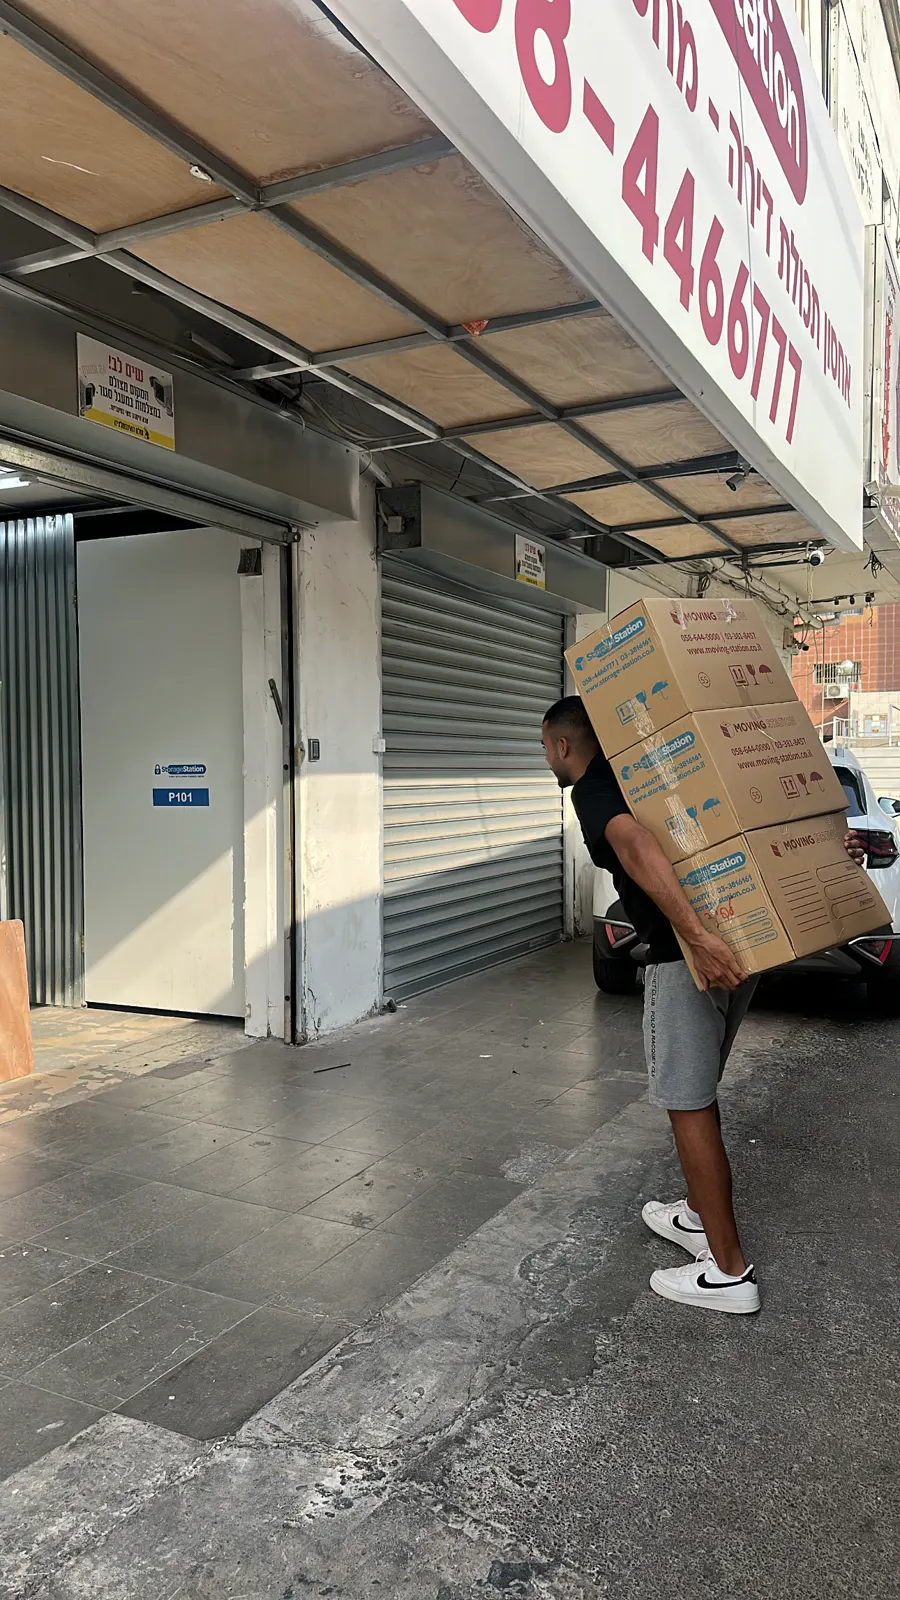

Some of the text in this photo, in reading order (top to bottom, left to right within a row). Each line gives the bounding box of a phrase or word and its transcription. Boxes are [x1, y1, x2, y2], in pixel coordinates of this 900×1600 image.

[728, 110, 774, 258] דירה
[778, 216, 821, 351] תכולת
[108, 355, 123, 374] לב!
[823, 311, 852, 410] אחסון
[125, 363, 144, 383] שים
[109, 375, 149, 402] המקום מצולם
[114, 390, 134, 408] במעגל
[135, 400, 162, 420] במצלמות
[684, 611, 717, 621] MOVING
[733, 720, 767, 733] MOVING
[737, 749, 813, 770] www.moving-station.co.il
[168, 792, 192, 803] P101
[783, 835, 816, 851] MOVING
